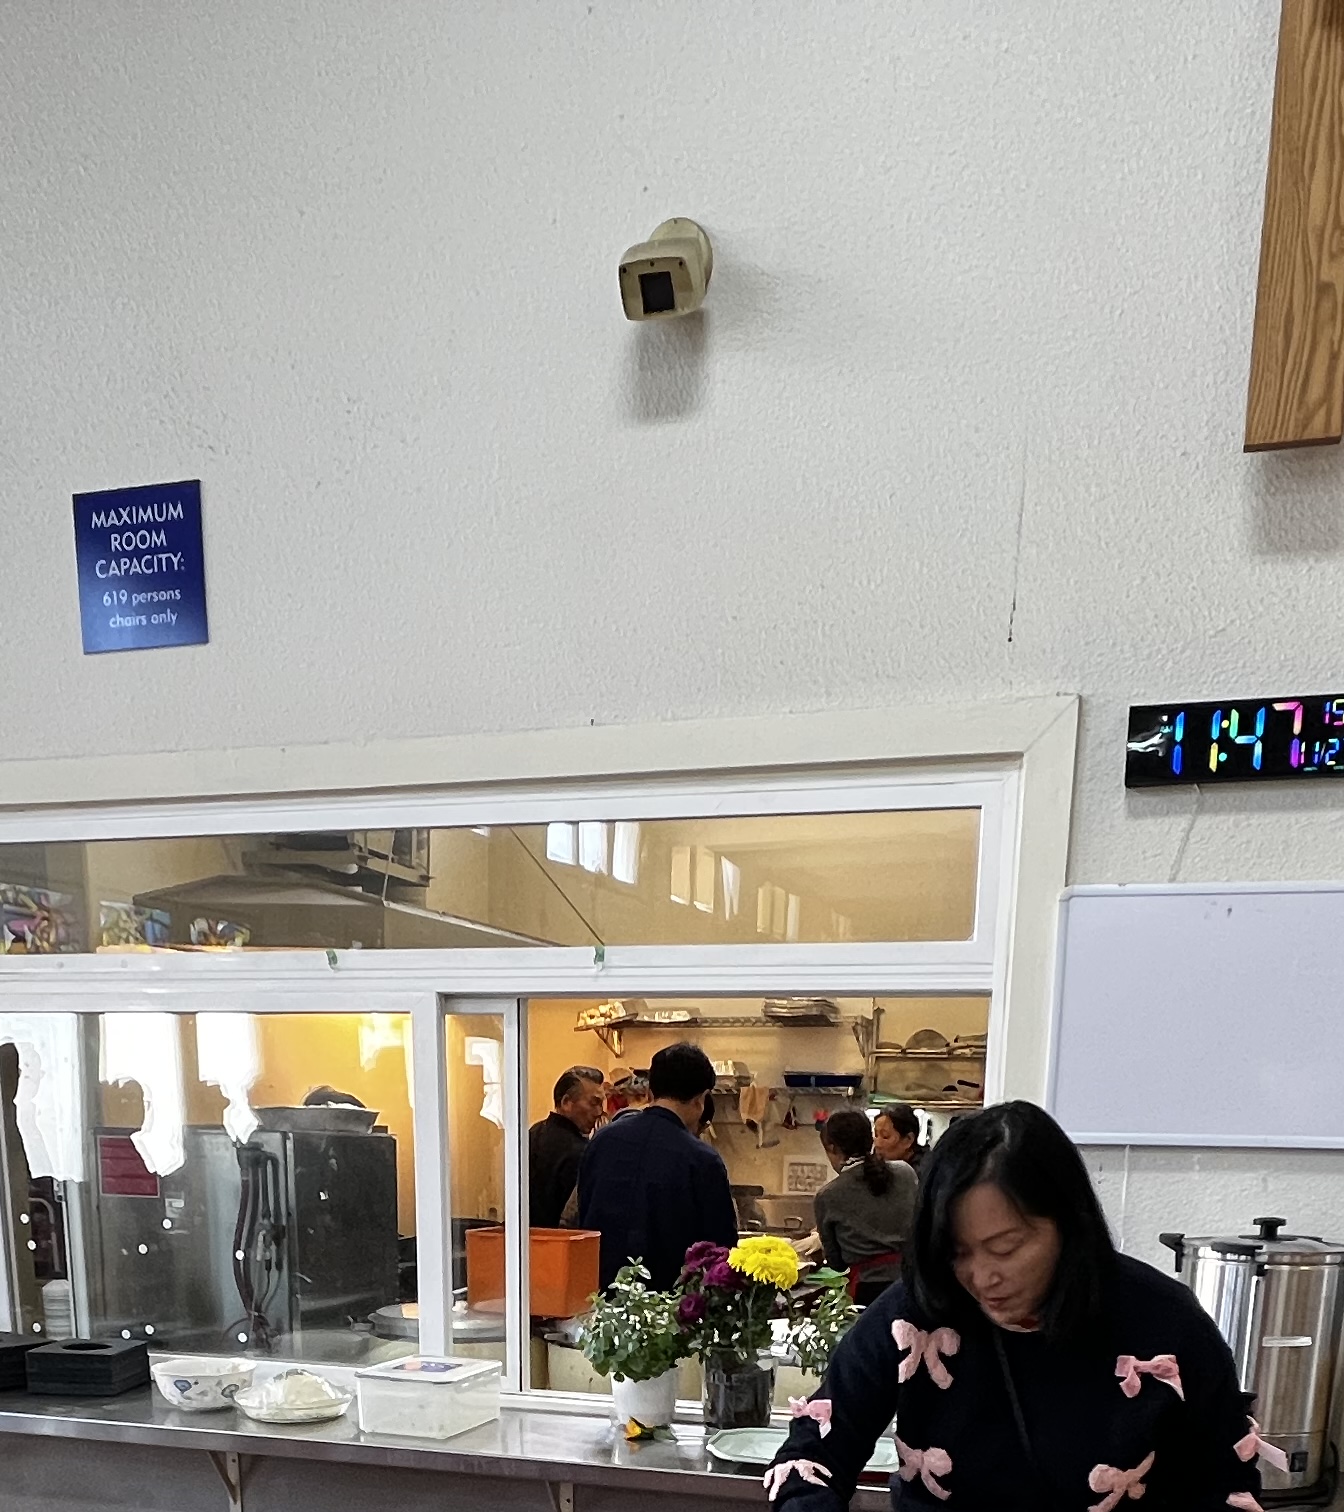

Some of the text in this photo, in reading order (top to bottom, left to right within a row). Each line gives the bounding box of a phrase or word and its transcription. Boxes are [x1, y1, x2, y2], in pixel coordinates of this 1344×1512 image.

[91, 501, 184, 529] MAXIMUM
[110, 528, 167, 553] ROOM
[95, 551, 185, 578] CAPACITY:
[103, 588, 182, 606] 619 persons
[109, 608, 178, 628] chairs only
[1171, 701, 1304, 775] 11:47
